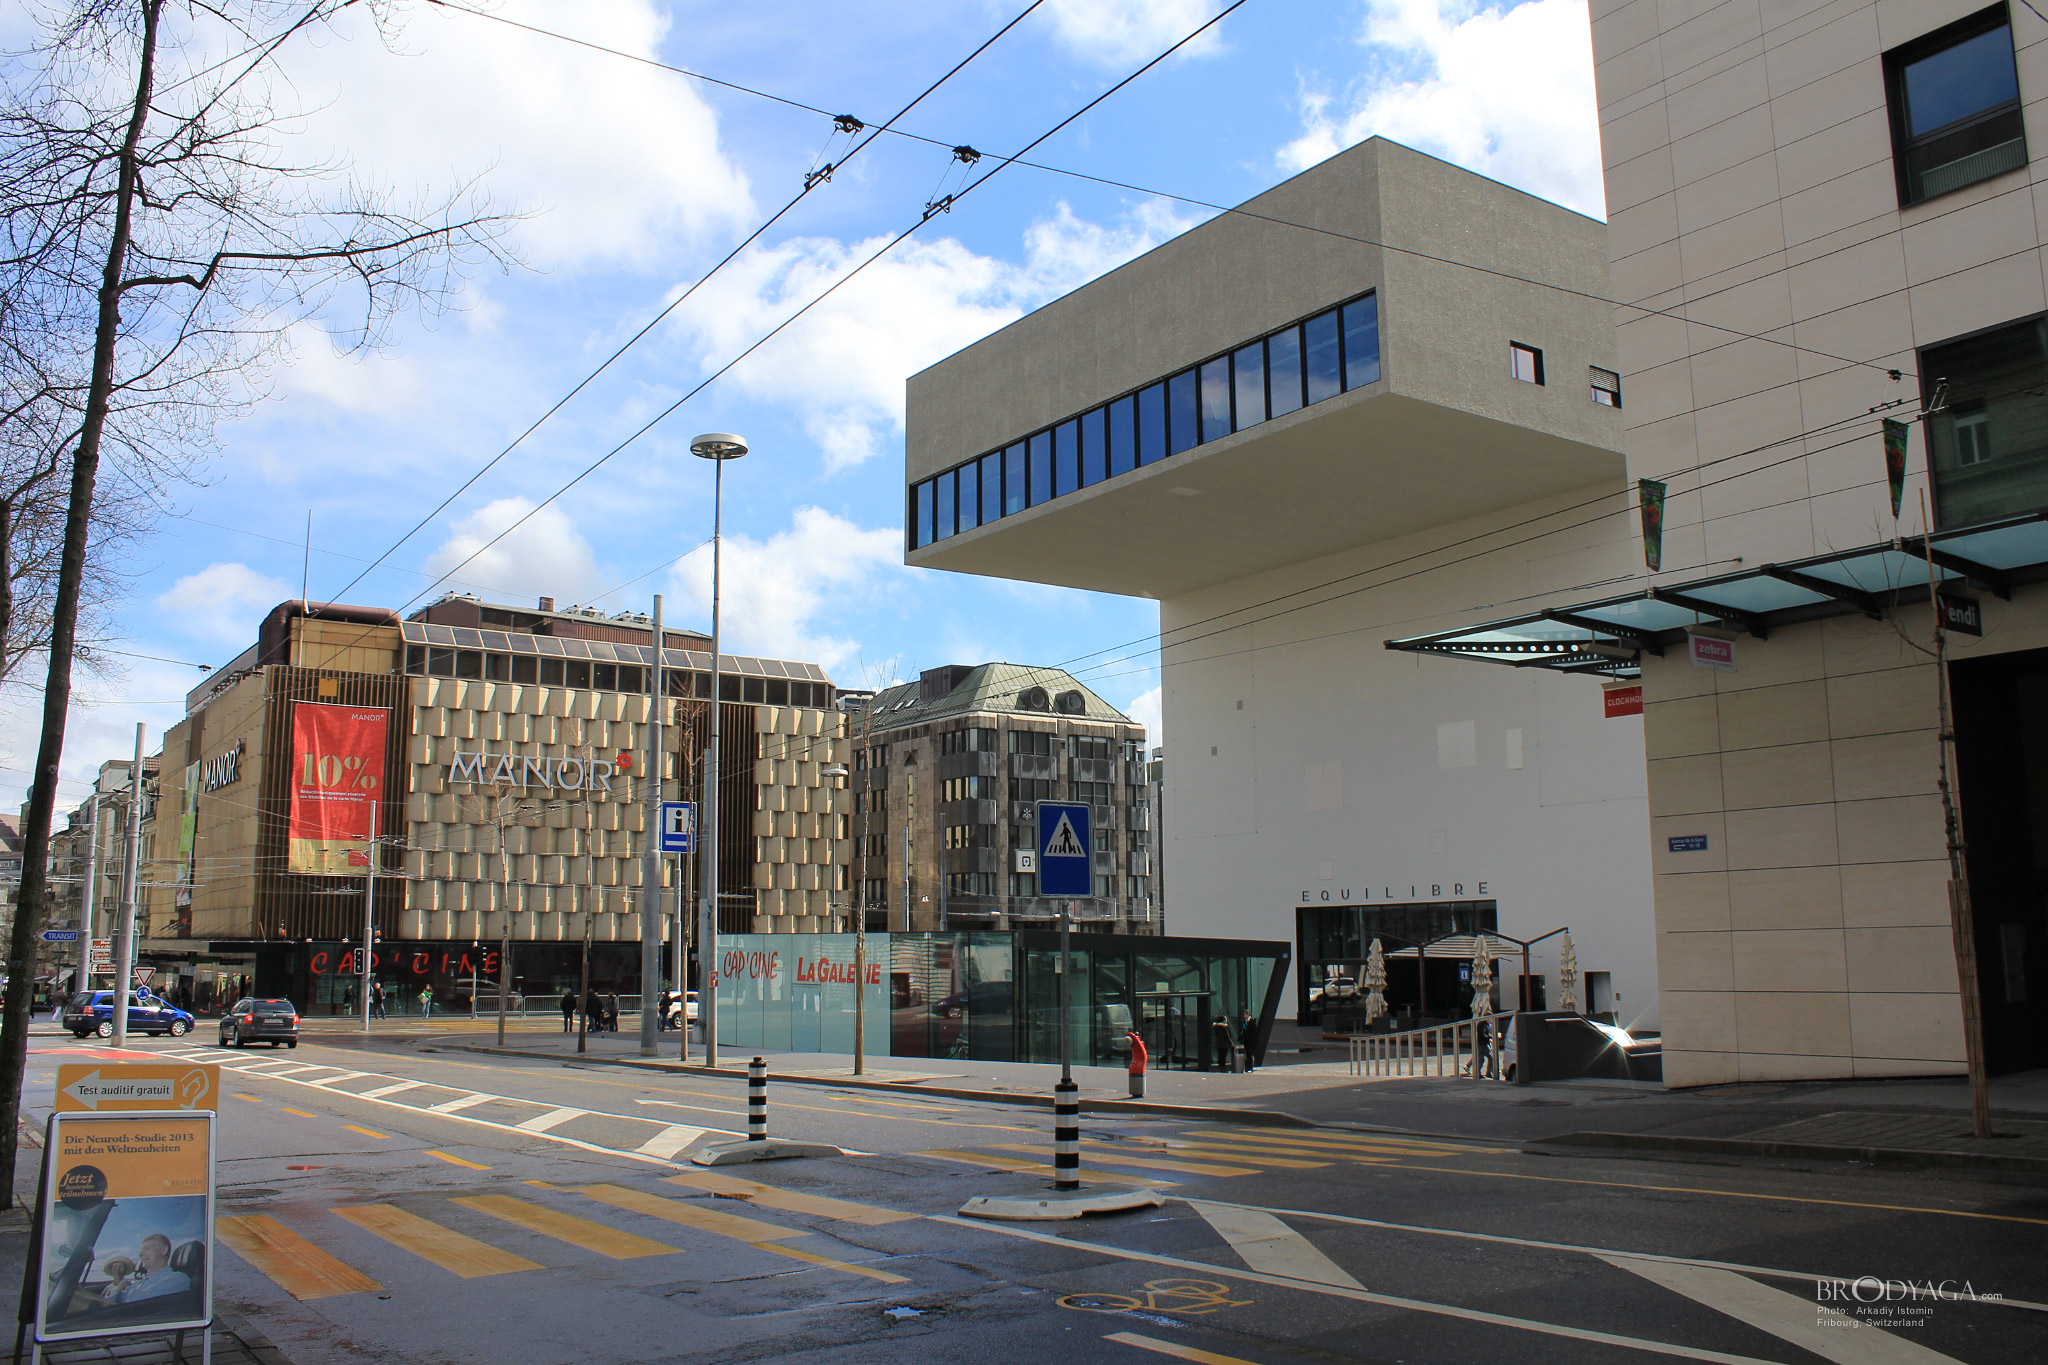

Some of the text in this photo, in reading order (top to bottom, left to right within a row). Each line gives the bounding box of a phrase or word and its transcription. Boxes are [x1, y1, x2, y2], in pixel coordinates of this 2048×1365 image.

[1698, 643, 1727, 656] zebra
[351, 713, 381, 722] MANOR
[203, 750, 236, 793] MANOR
[301, 753, 377, 789] 10%
[448, 751, 612, 791] MANOR
[1302, 882, 1488, 902] EQUILIBRE
[48, 932, 76, 940] TRANSIT
[723, 950, 778, 980] CAP'CINE
[78, 1085, 170, 1096] Test auditif gratuit
[65, 1133, 194, 1144] Die Neuroth-Studie 2013
[64, 1144, 180, 1155] mit den Weltneuheiten
[60, 1173, 94, 1187] Jetzt
[60, 1190, 107, 1198] teilnehmen!
